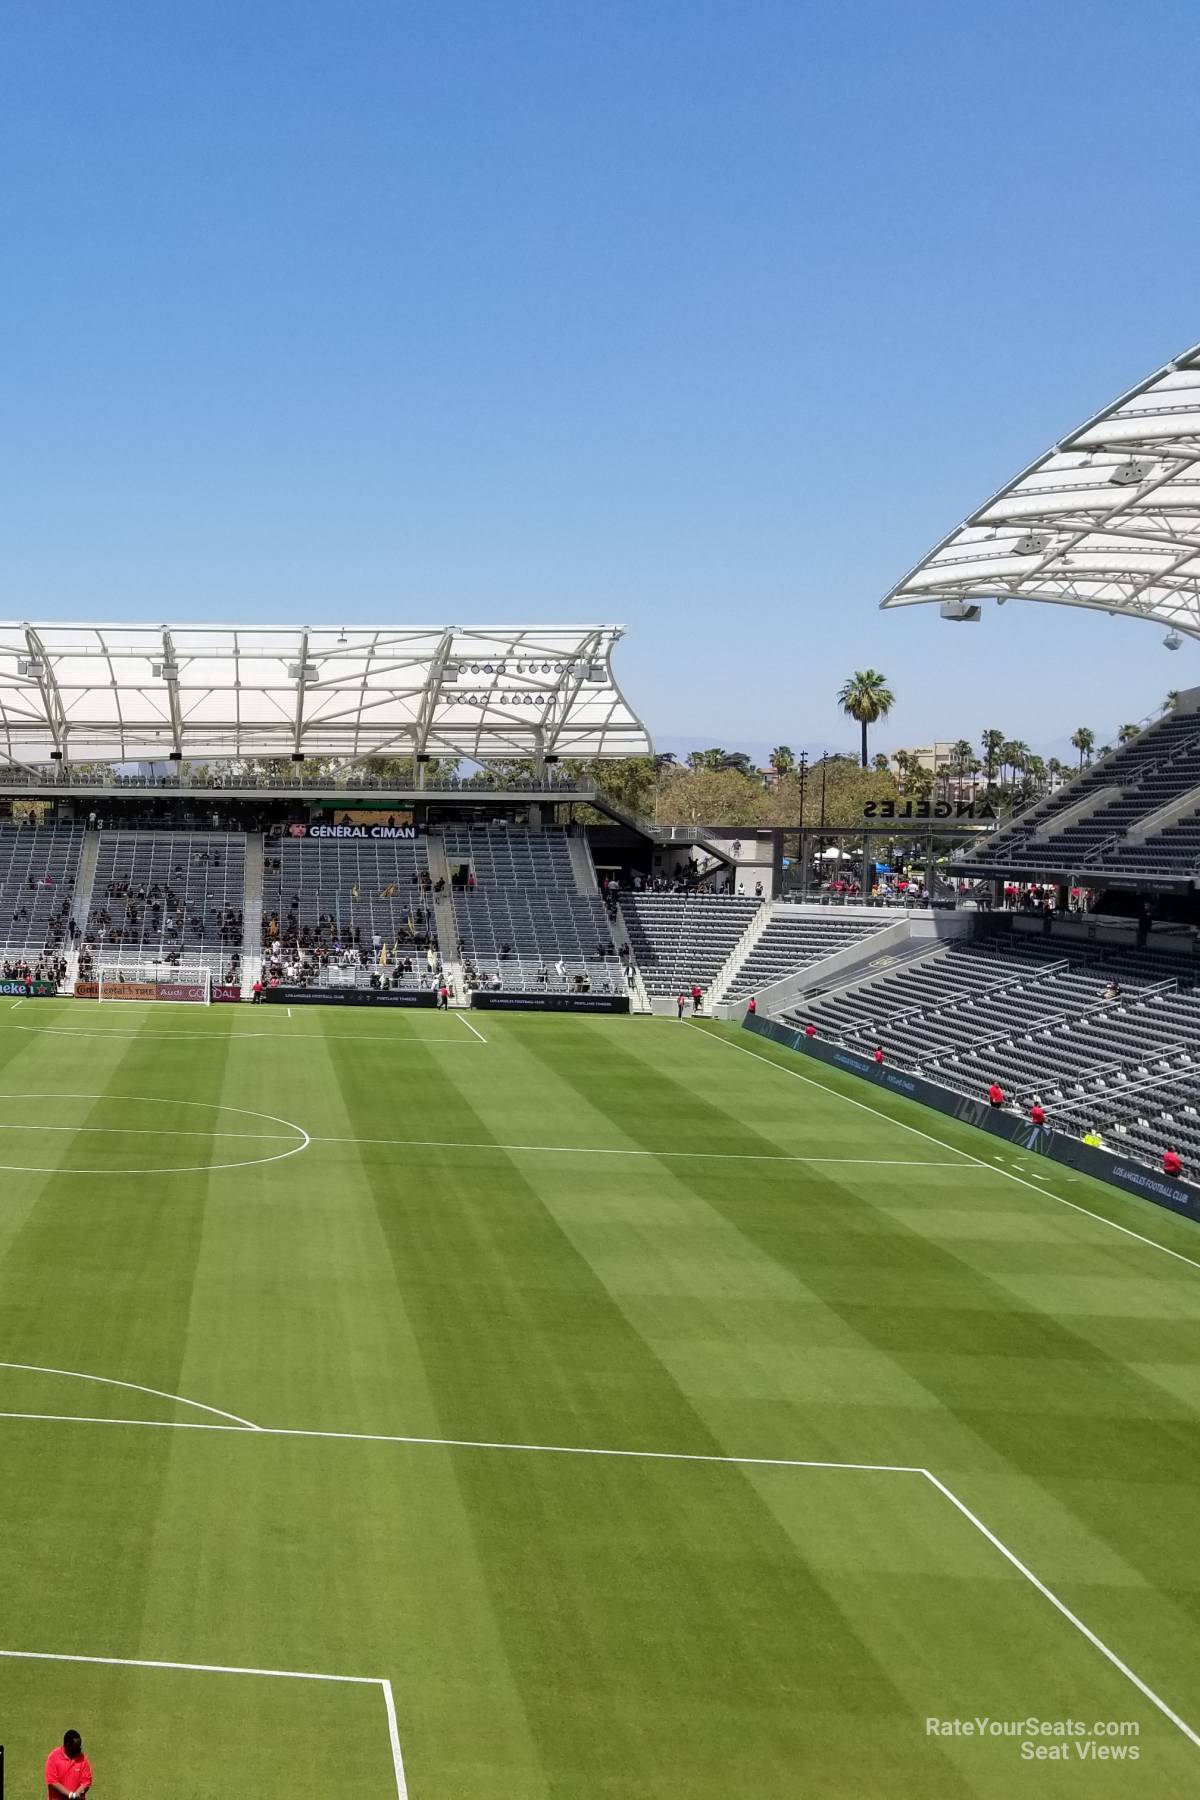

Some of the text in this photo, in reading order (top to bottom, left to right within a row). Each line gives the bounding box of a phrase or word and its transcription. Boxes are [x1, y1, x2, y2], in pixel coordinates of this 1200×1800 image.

[309, 824, 415, 838] GÉNÉRAL CIMAN
[160, 988, 183, 996] Audi
[1123, 1170, 1146, 1186] ANGELES
[1146, 1179, 1172, 1198] FOOTBALL
